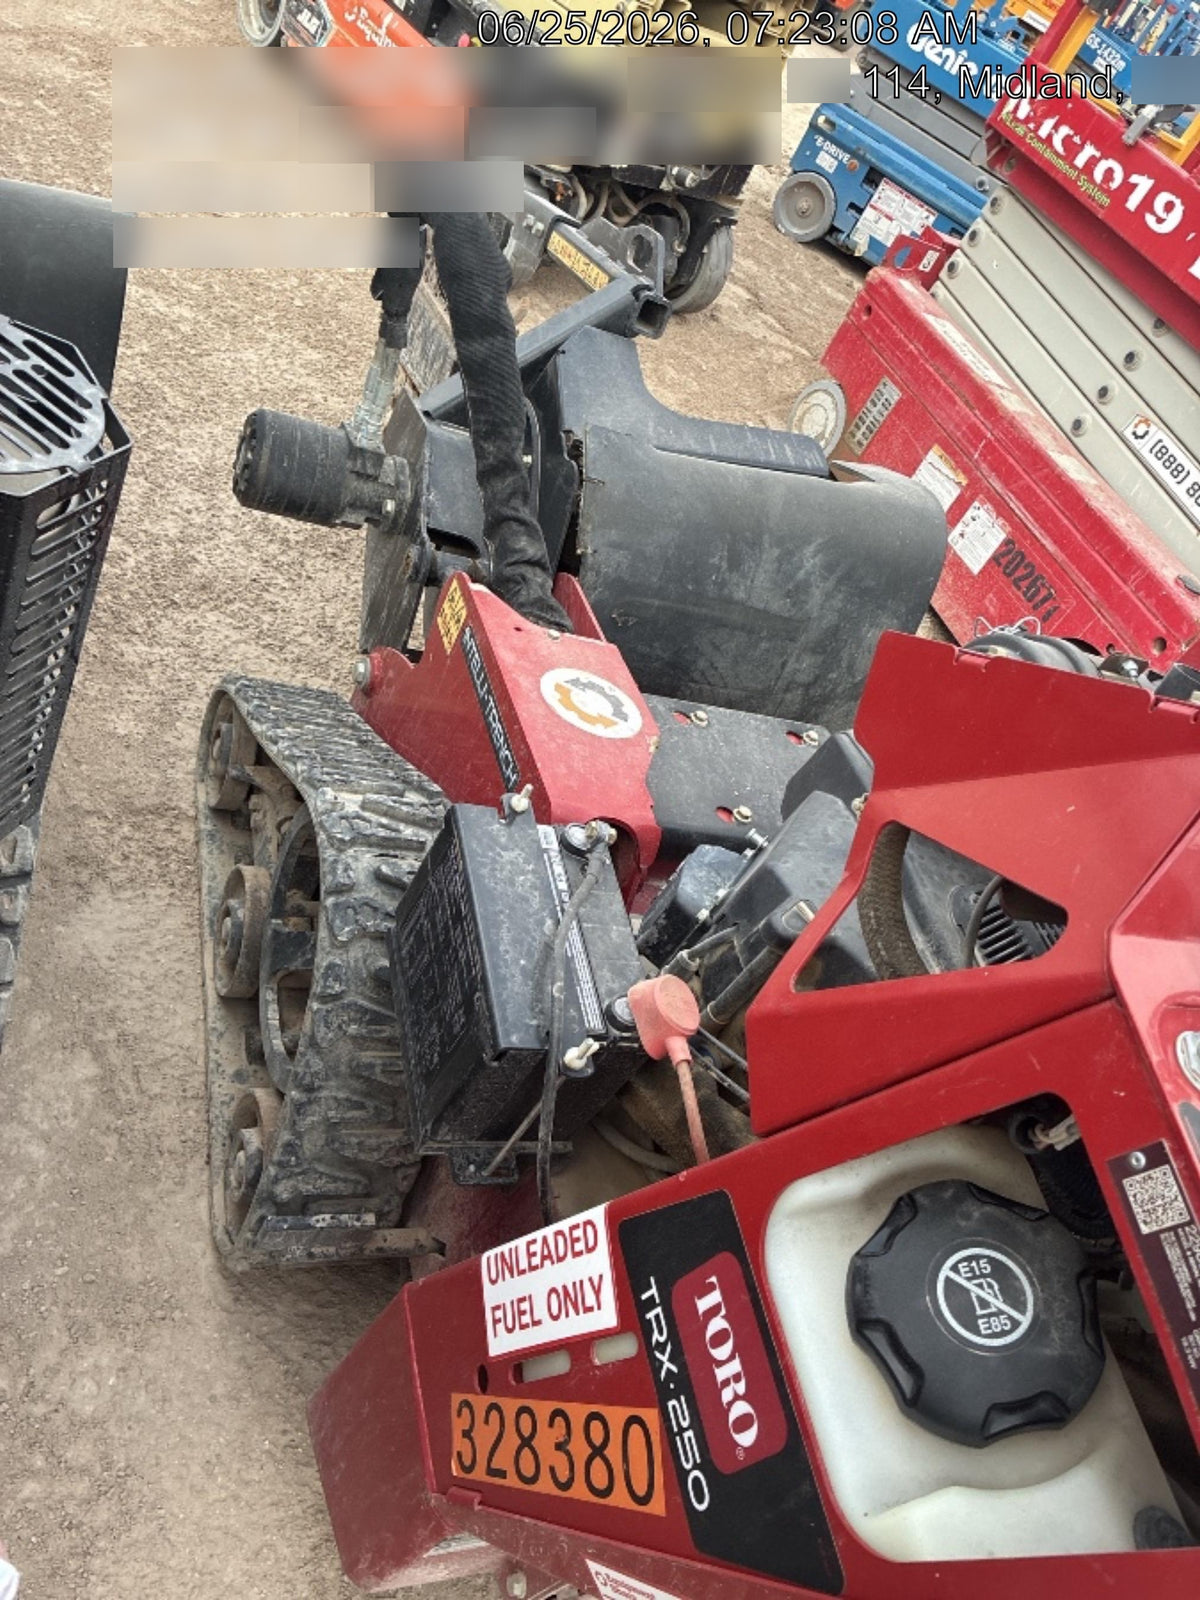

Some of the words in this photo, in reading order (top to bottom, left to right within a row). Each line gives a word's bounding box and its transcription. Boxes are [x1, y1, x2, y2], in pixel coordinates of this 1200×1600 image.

[1075, 174, 1112, 208] System
[1149, 438, 1190, 485] (888)
[486, 1218, 599, 1286] UNLEADED
[958, 1258, 991, 1278] E15
[490, 1295, 543, 1339] FUEL
[546, 1273, 604, 1322] ONLY
[977, 1314, 1011, 1335] E85
[694, 1275, 760, 1450] TORO
[456, 1397, 656, 1507] 328380
